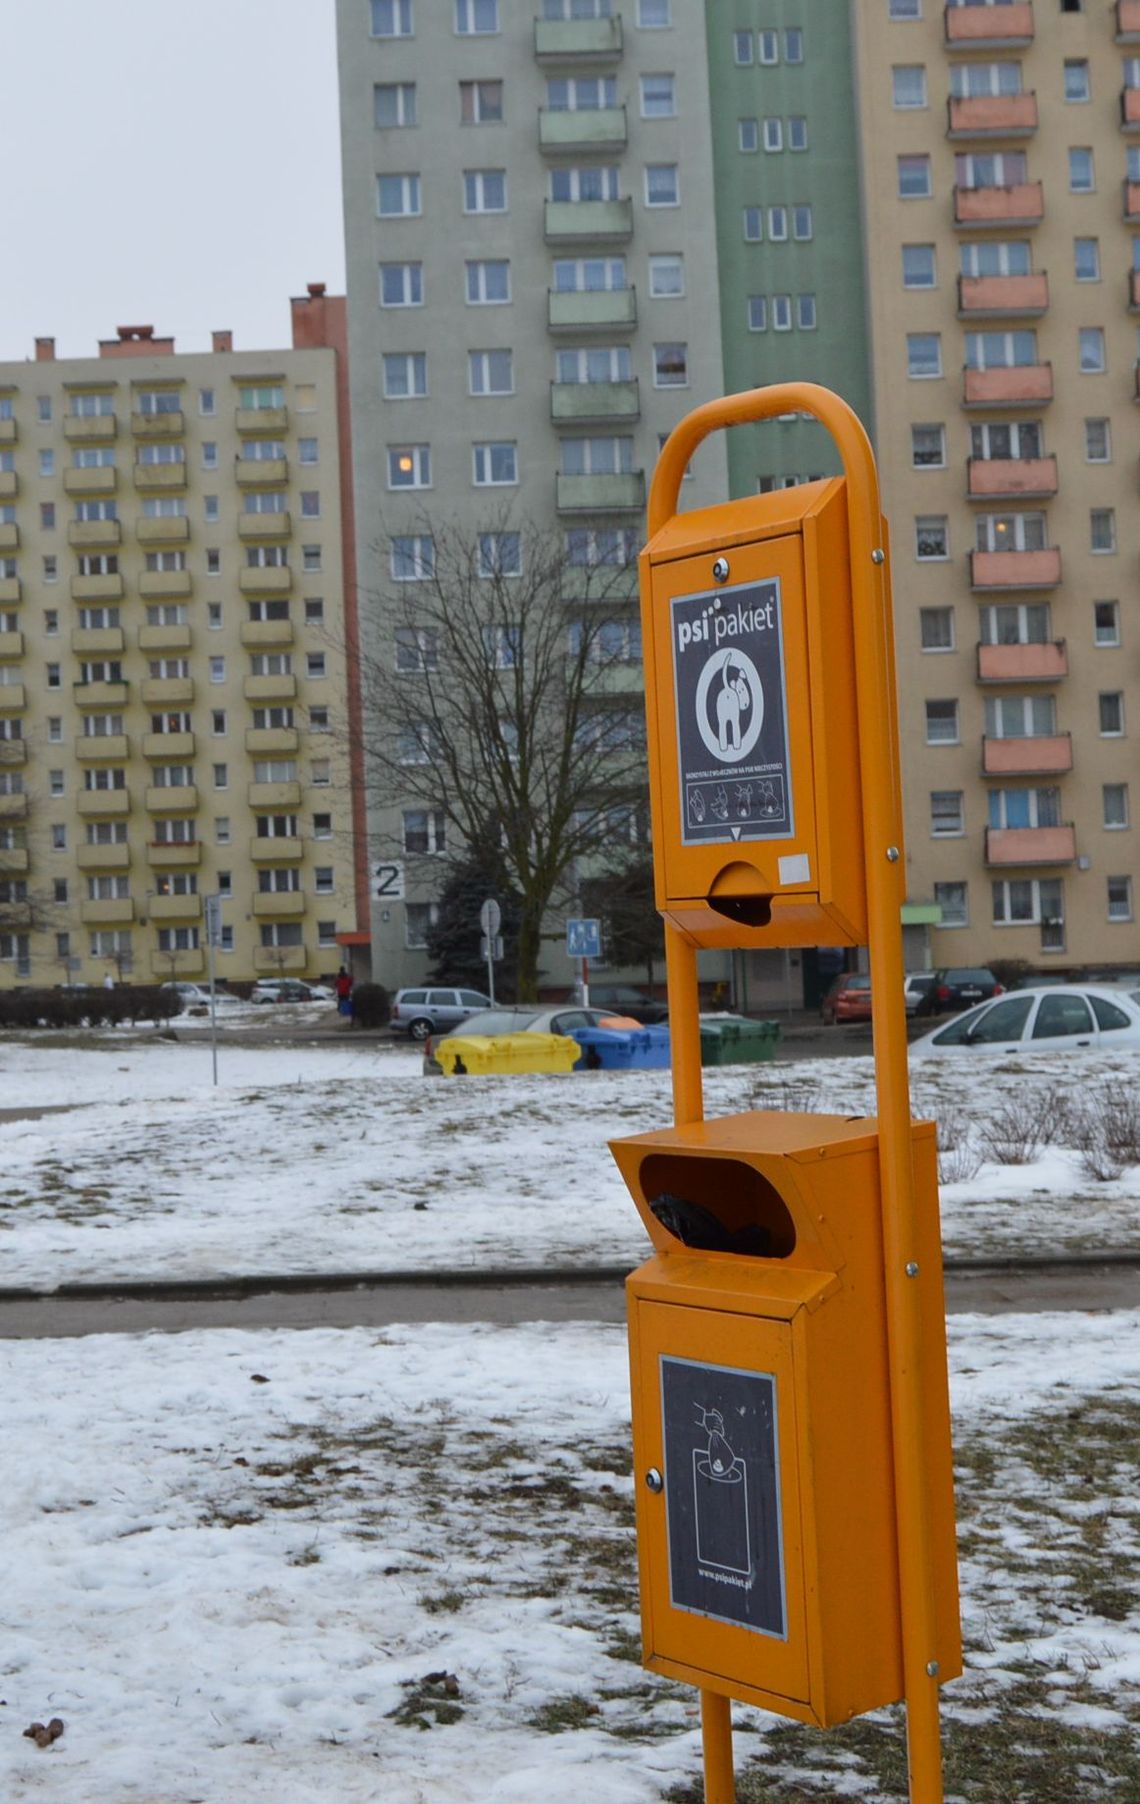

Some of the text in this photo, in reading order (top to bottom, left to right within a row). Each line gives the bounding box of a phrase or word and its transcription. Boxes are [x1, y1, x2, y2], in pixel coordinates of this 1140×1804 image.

[678, 602, 774, 652] psi pakiet
[376, 866, 400, 896] 2
